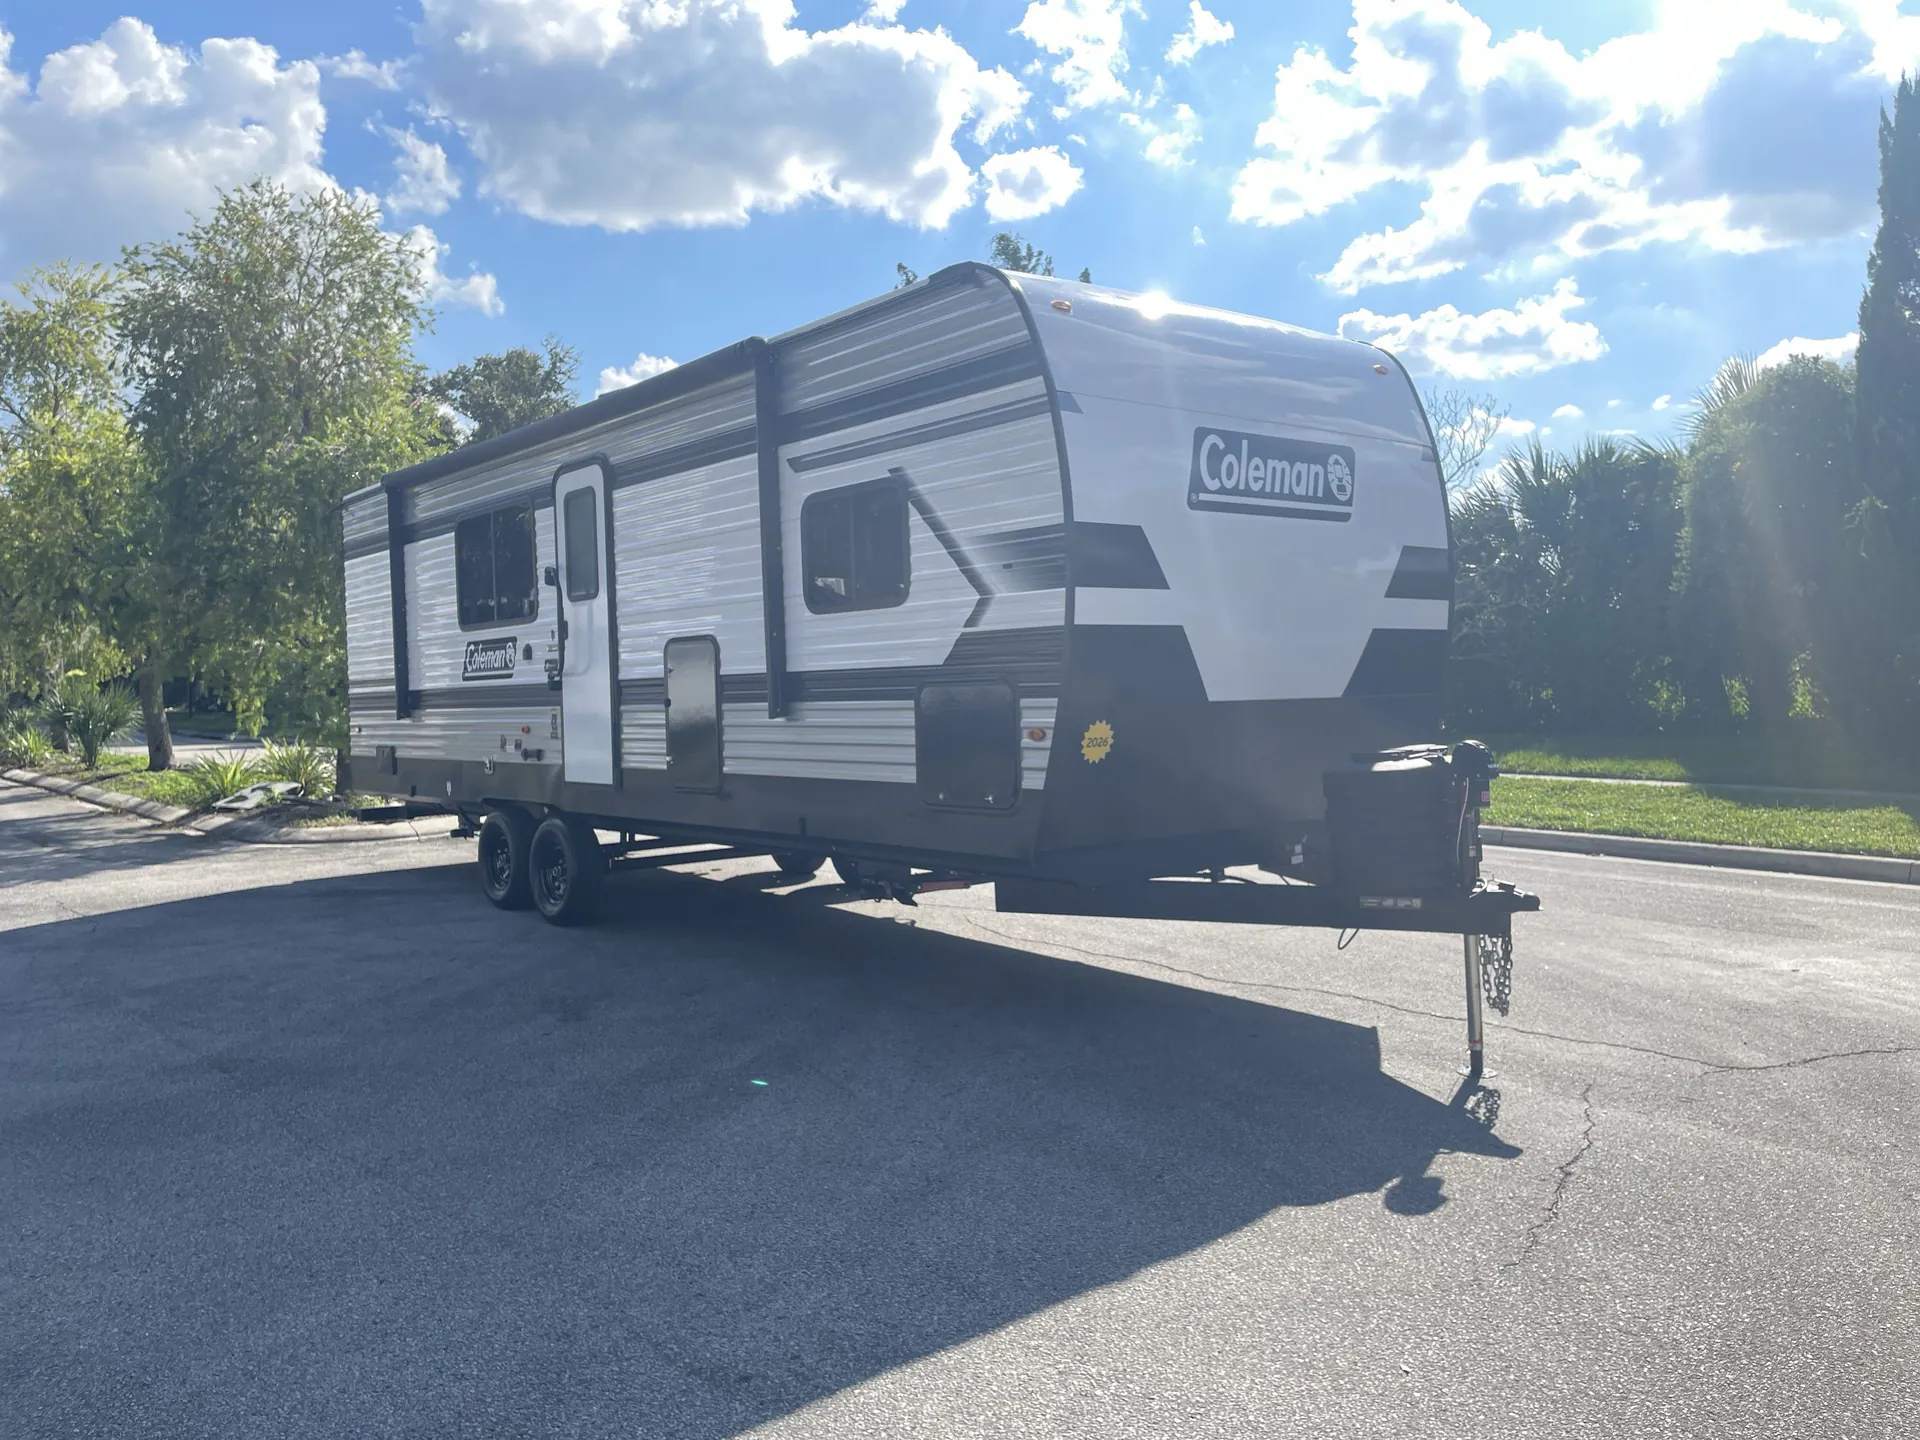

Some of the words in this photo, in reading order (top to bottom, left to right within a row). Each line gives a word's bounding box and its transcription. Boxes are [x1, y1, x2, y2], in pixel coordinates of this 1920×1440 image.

[1200, 434, 1325, 498] Coleman
[467, 644, 505, 672] Coleman
[1086, 737, 1109, 748] 2026
